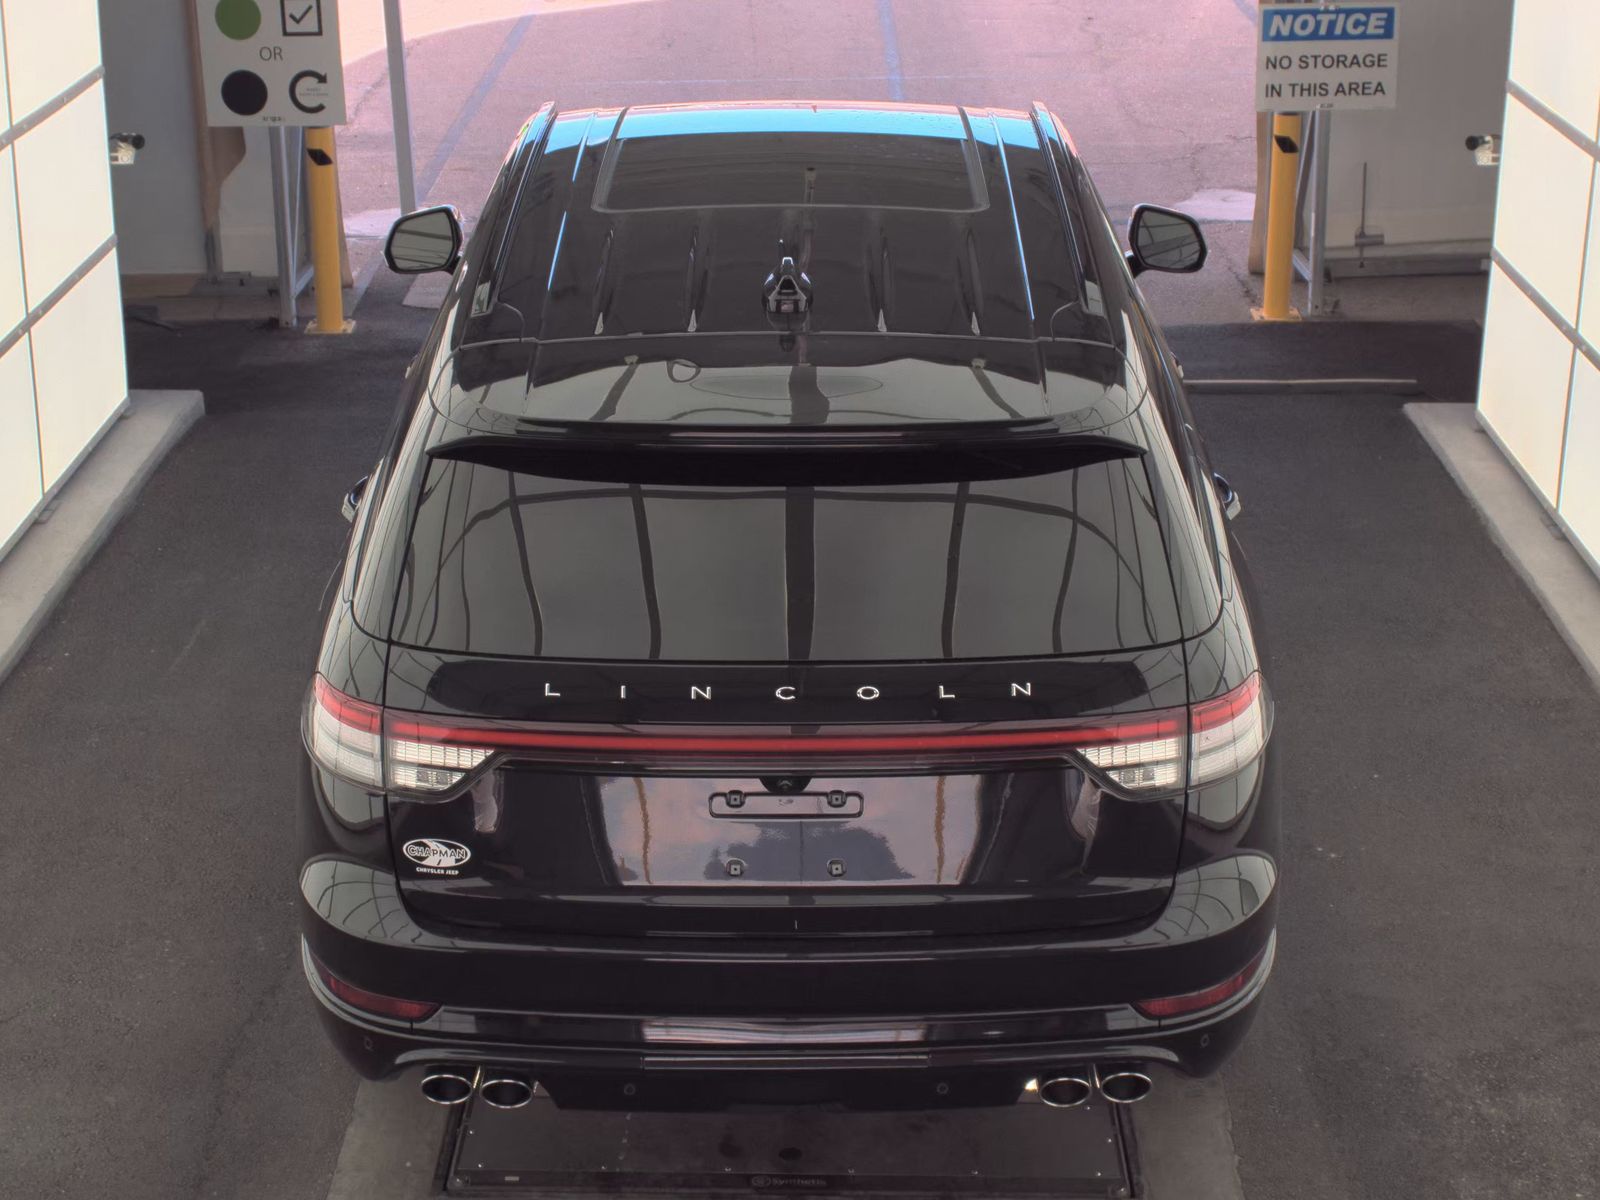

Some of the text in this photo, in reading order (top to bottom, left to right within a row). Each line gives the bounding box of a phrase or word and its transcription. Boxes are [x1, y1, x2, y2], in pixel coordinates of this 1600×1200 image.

[1268, 12, 1388, 37] NOTICE
[259, 46, 284, 62] OR
[1265, 53, 1388, 70] NO STORAGE
[1265, 81, 1386, 98] IN THIS AREA
[544, 682, 1032, 701] LINCOLN
[407, 844, 466, 859] CHAPMAN
[416, 866, 445, 875] CHRYSLER
